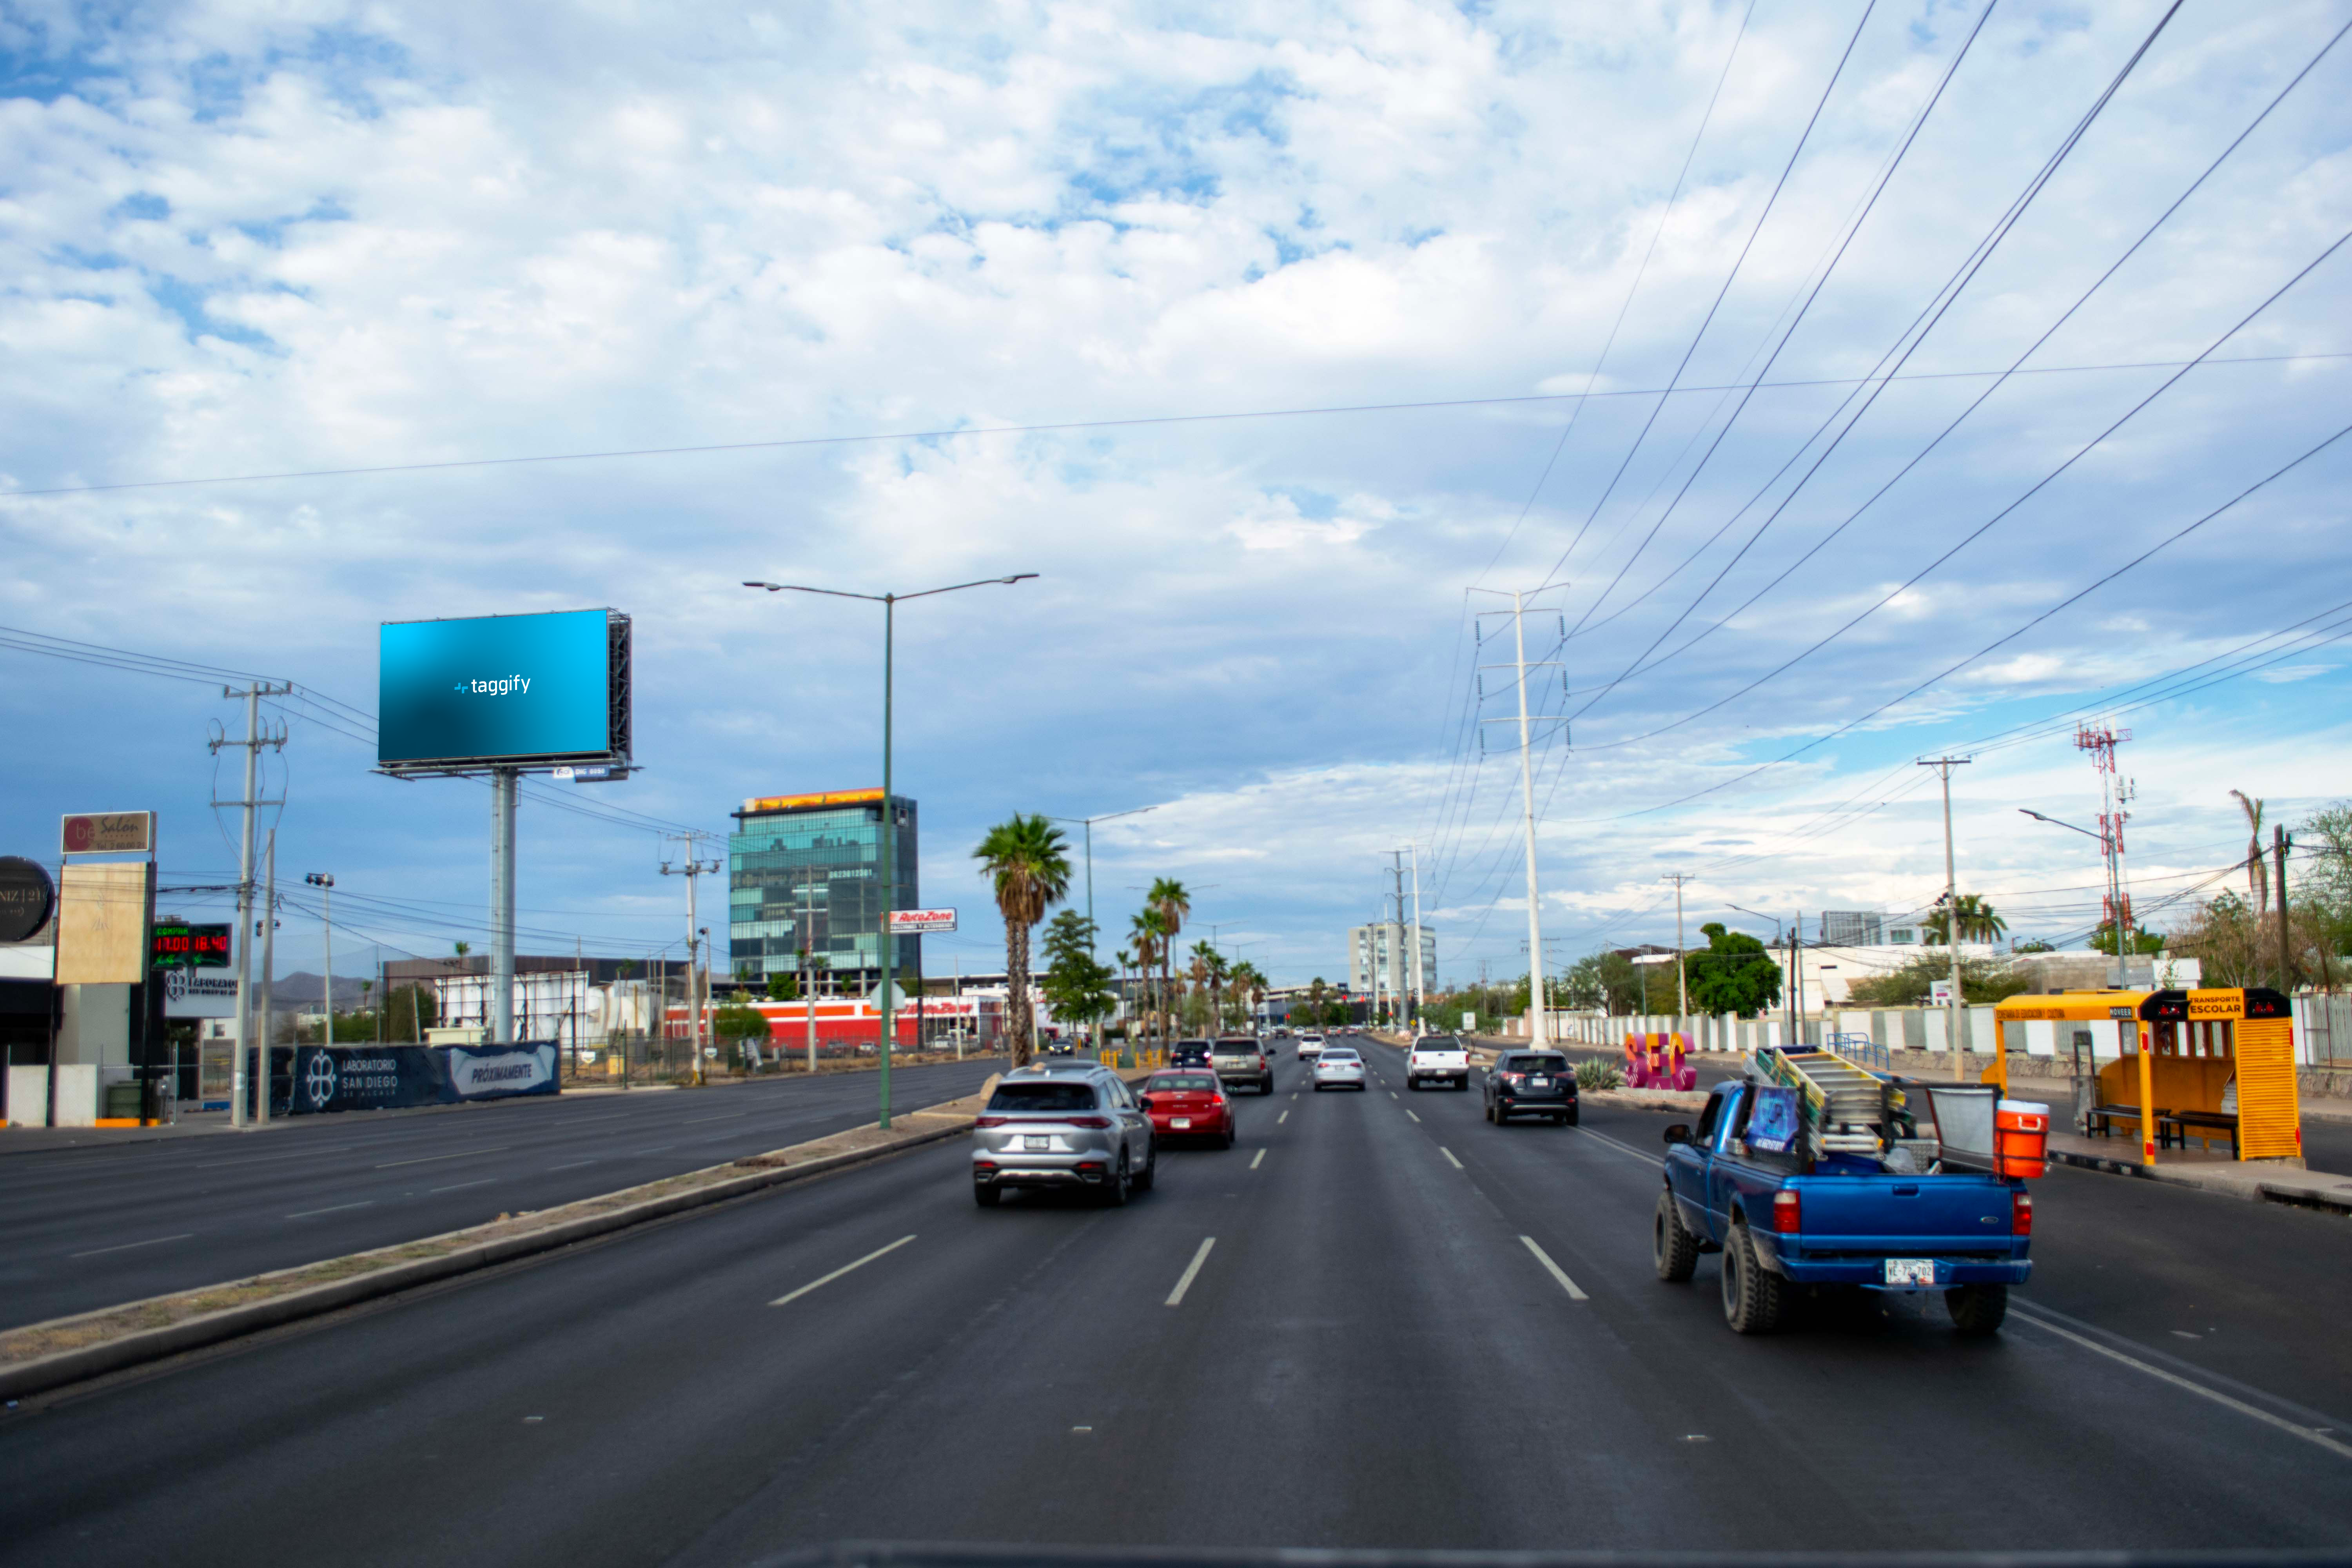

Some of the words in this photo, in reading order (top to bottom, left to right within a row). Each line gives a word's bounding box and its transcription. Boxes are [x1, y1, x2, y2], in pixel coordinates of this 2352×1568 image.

[471, 674, 531, 696] taggify
[899, 911, 952, 922] AutoZone
[2190, 1005, 2241, 1013] ESCOLAR
[343, 1059, 396, 1071] LABORATORIO
[1624, 1032, 1697, 1091] SEC
[472, 1063, 532, 1083] PRÓXIMAMENTE
[343, 1077, 362, 1089] SAN
[367, 1076, 398, 1087] DIEGO
